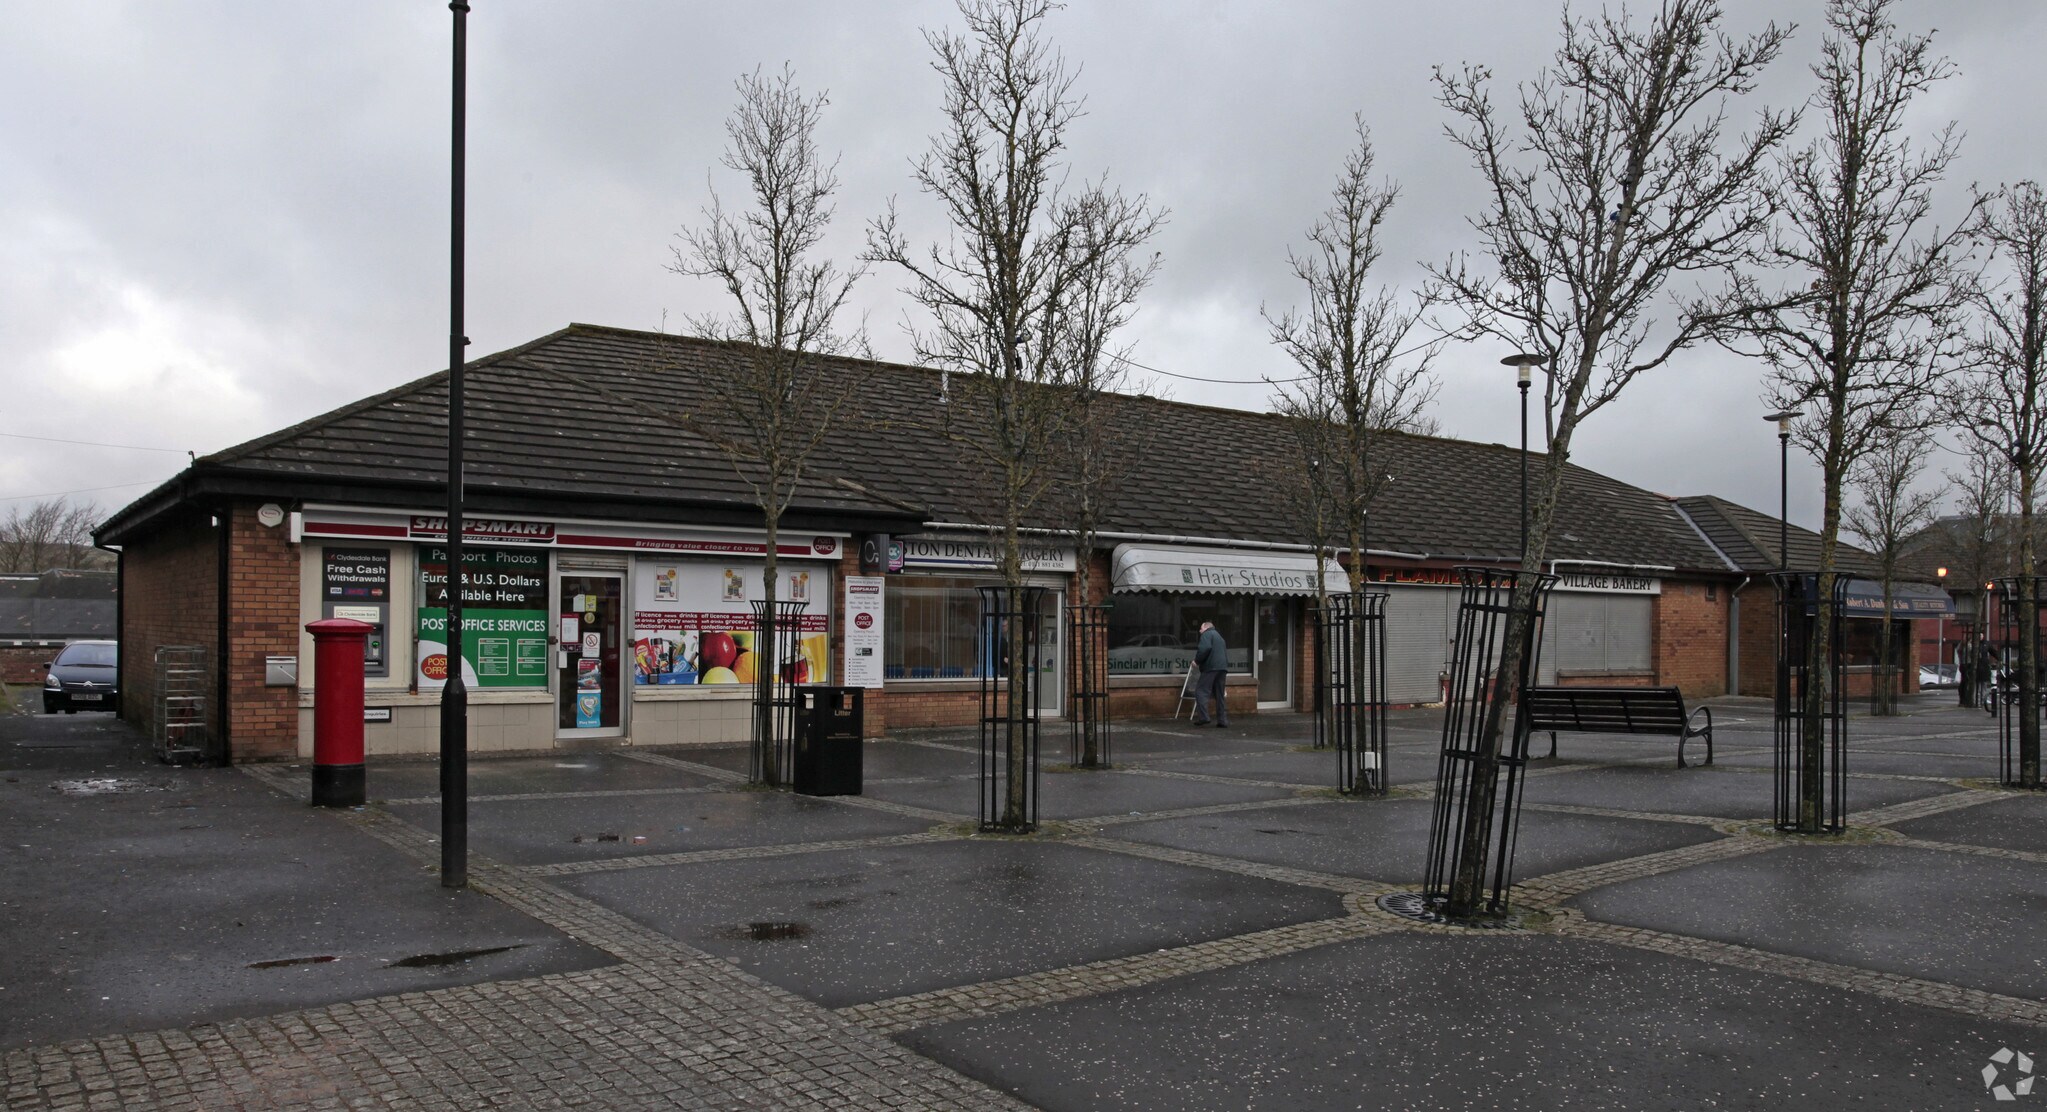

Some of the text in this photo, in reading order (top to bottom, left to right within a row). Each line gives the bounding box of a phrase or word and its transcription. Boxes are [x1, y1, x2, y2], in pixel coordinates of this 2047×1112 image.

[413, 517, 552, 535] SHPSMART
[635, 540, 675, 549] Bringing
[336, 554, 371, 562] Clydesdale
[432, 549, 538, 564] Paport Photos
[1020, 545, 1065, 562] RGERY
[327, 564, 386, 574] Free Cash
[327, 574, 386, 583] Withdrawals
[461, 573, 469, 584] &
[473, 573, 496, 585] U.S.
[499, 574, 541, 587] Dollars
[1197, 567, 1302, 588] Hair Studios
[1562, 574, 1653, 591] VILLAGE BAKERY
[438, 588, 525, 602] Ailable Here
[497, 619, 546, 632] SERVICES
[1107, 656, 1147, 670] Sinclair
[1150, 657, 1172, 669] Hair
[424, 666, 448, 675] OFFIC
[834, 709, 851, 717] Litter
